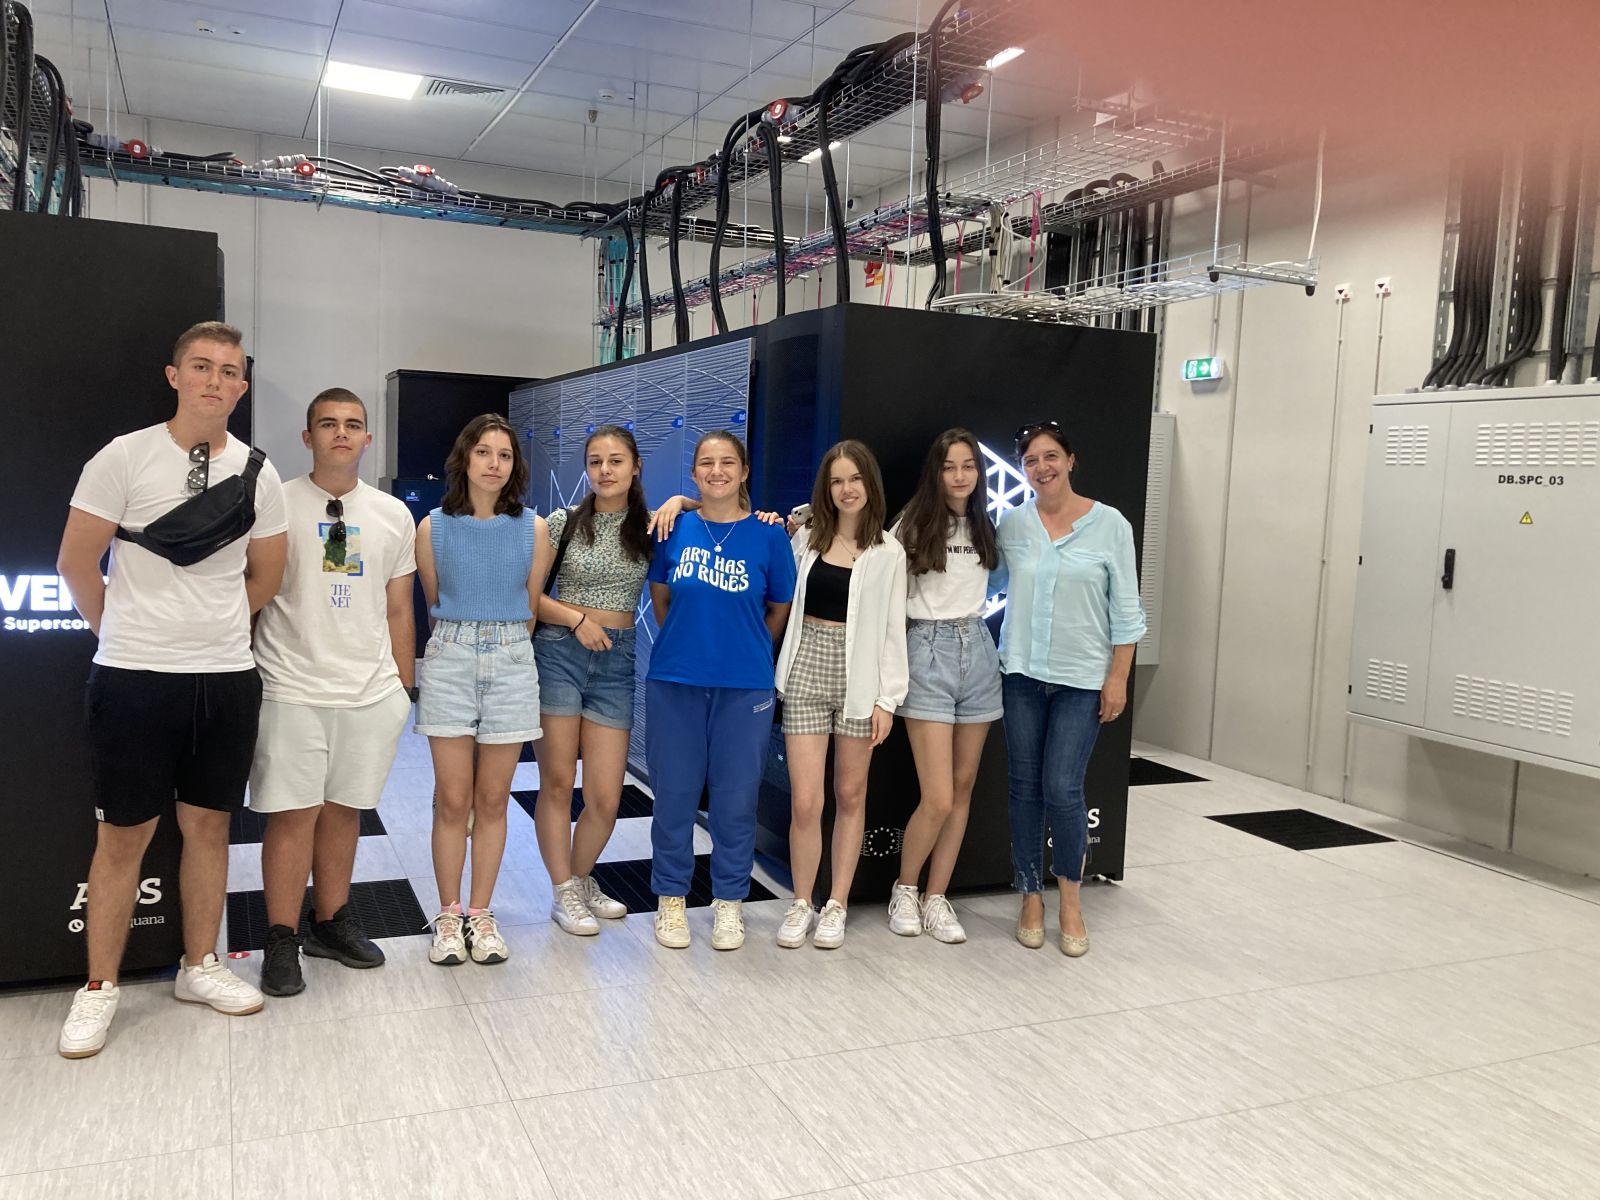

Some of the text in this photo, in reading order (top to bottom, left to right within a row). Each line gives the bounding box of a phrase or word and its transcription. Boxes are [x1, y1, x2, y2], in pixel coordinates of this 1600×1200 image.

[1498, 475, 1565, 487] DB.SPC_03
[680, 546, 746, 575] ART HAS
[672, 561, 750, 592] NO RULES
